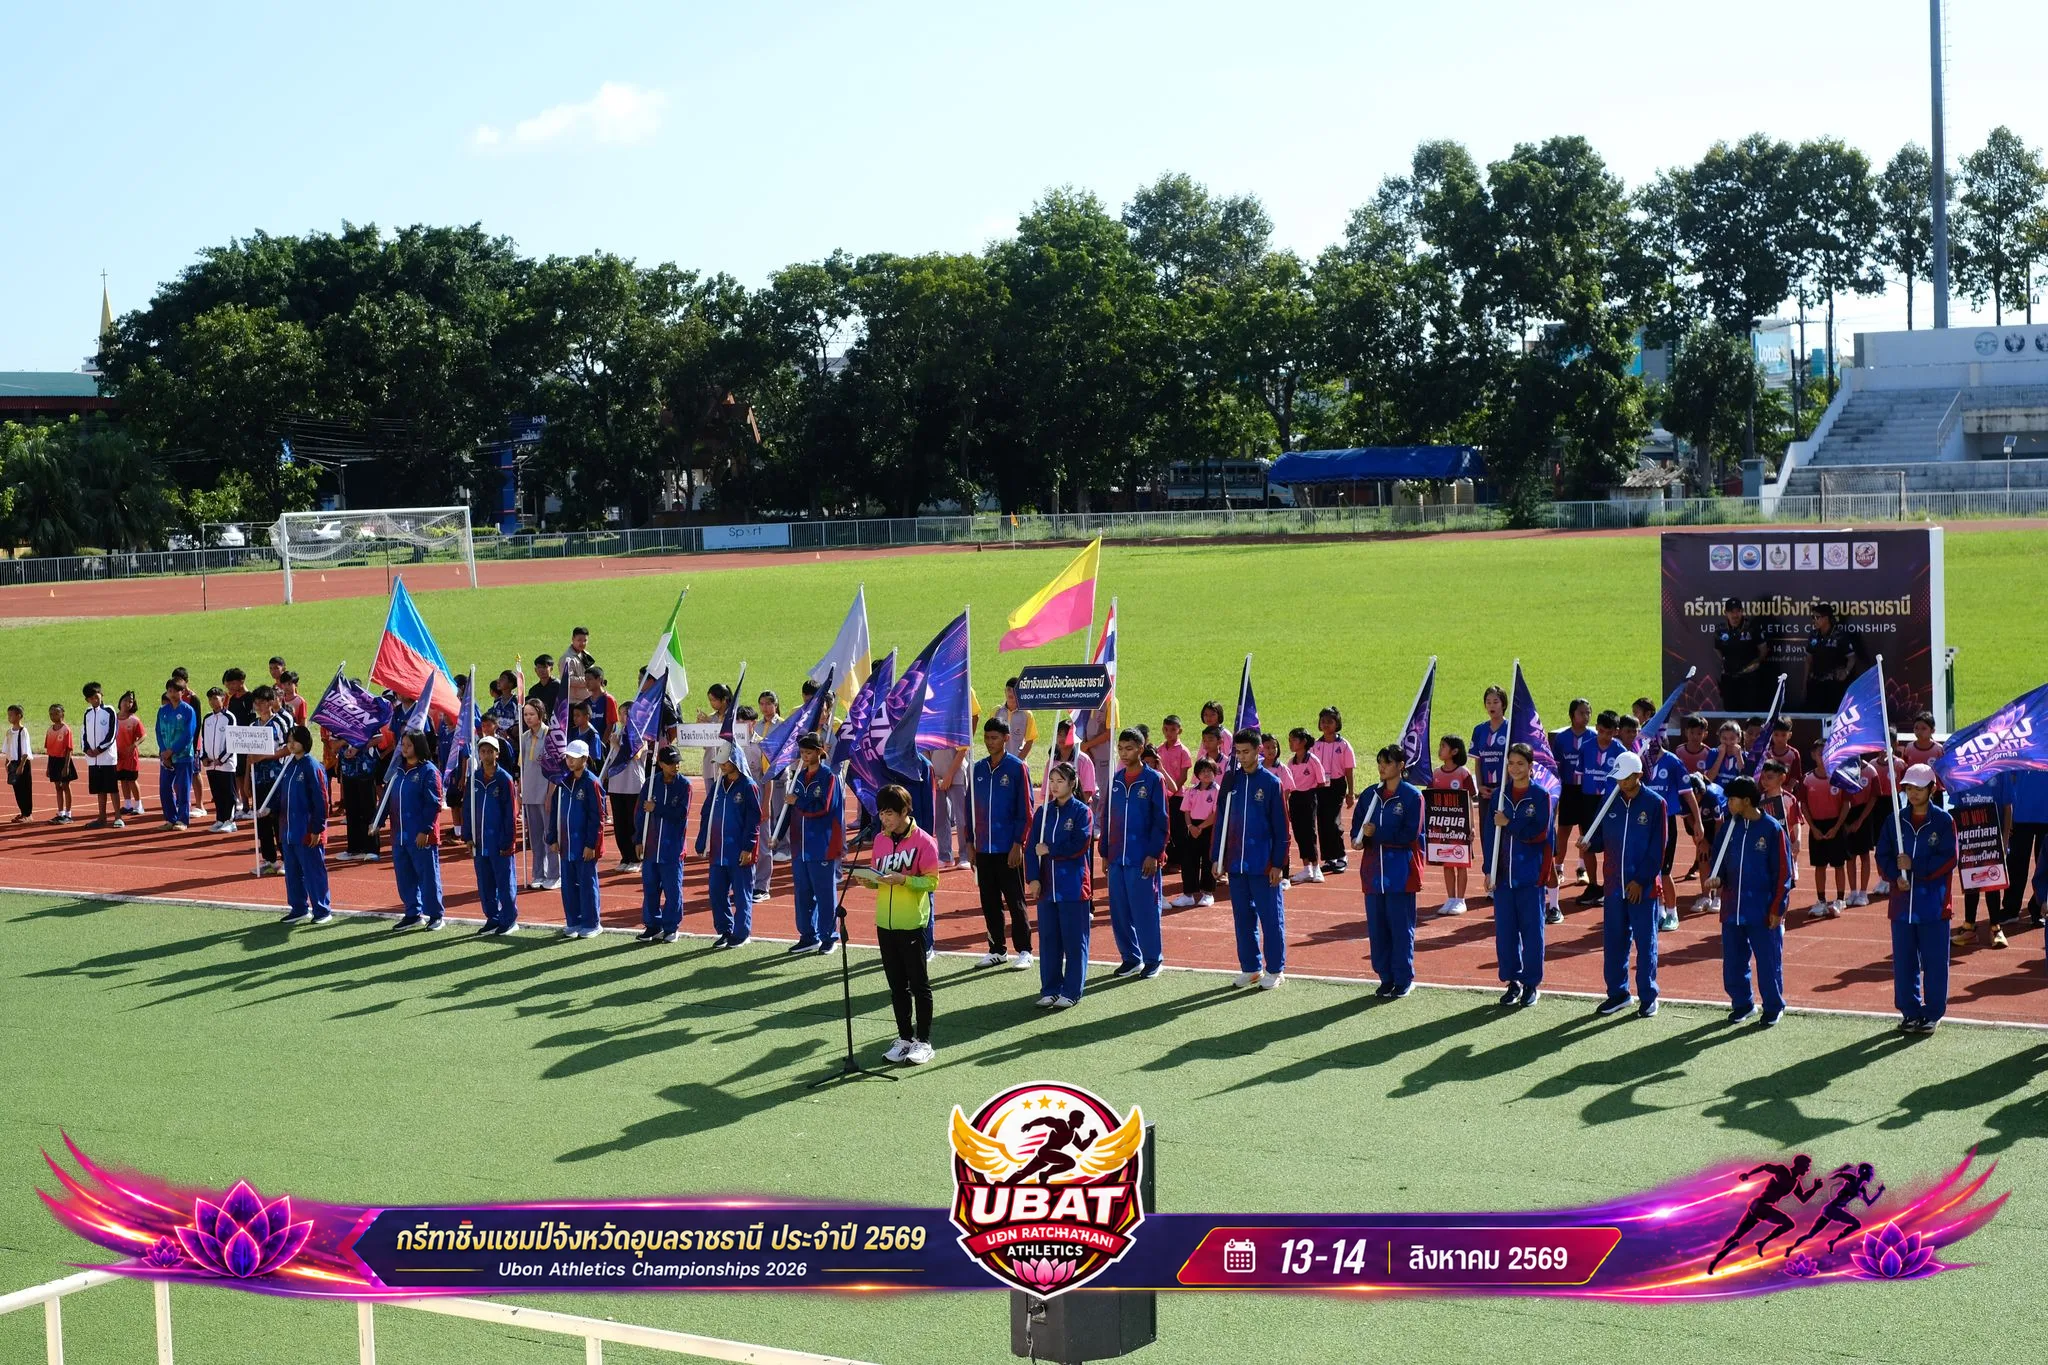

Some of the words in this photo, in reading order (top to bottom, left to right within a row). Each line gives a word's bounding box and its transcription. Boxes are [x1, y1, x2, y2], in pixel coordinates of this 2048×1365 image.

[324, 690, 379, 725] UBON
[1429, 815, 1466, 832] คนอุบล
